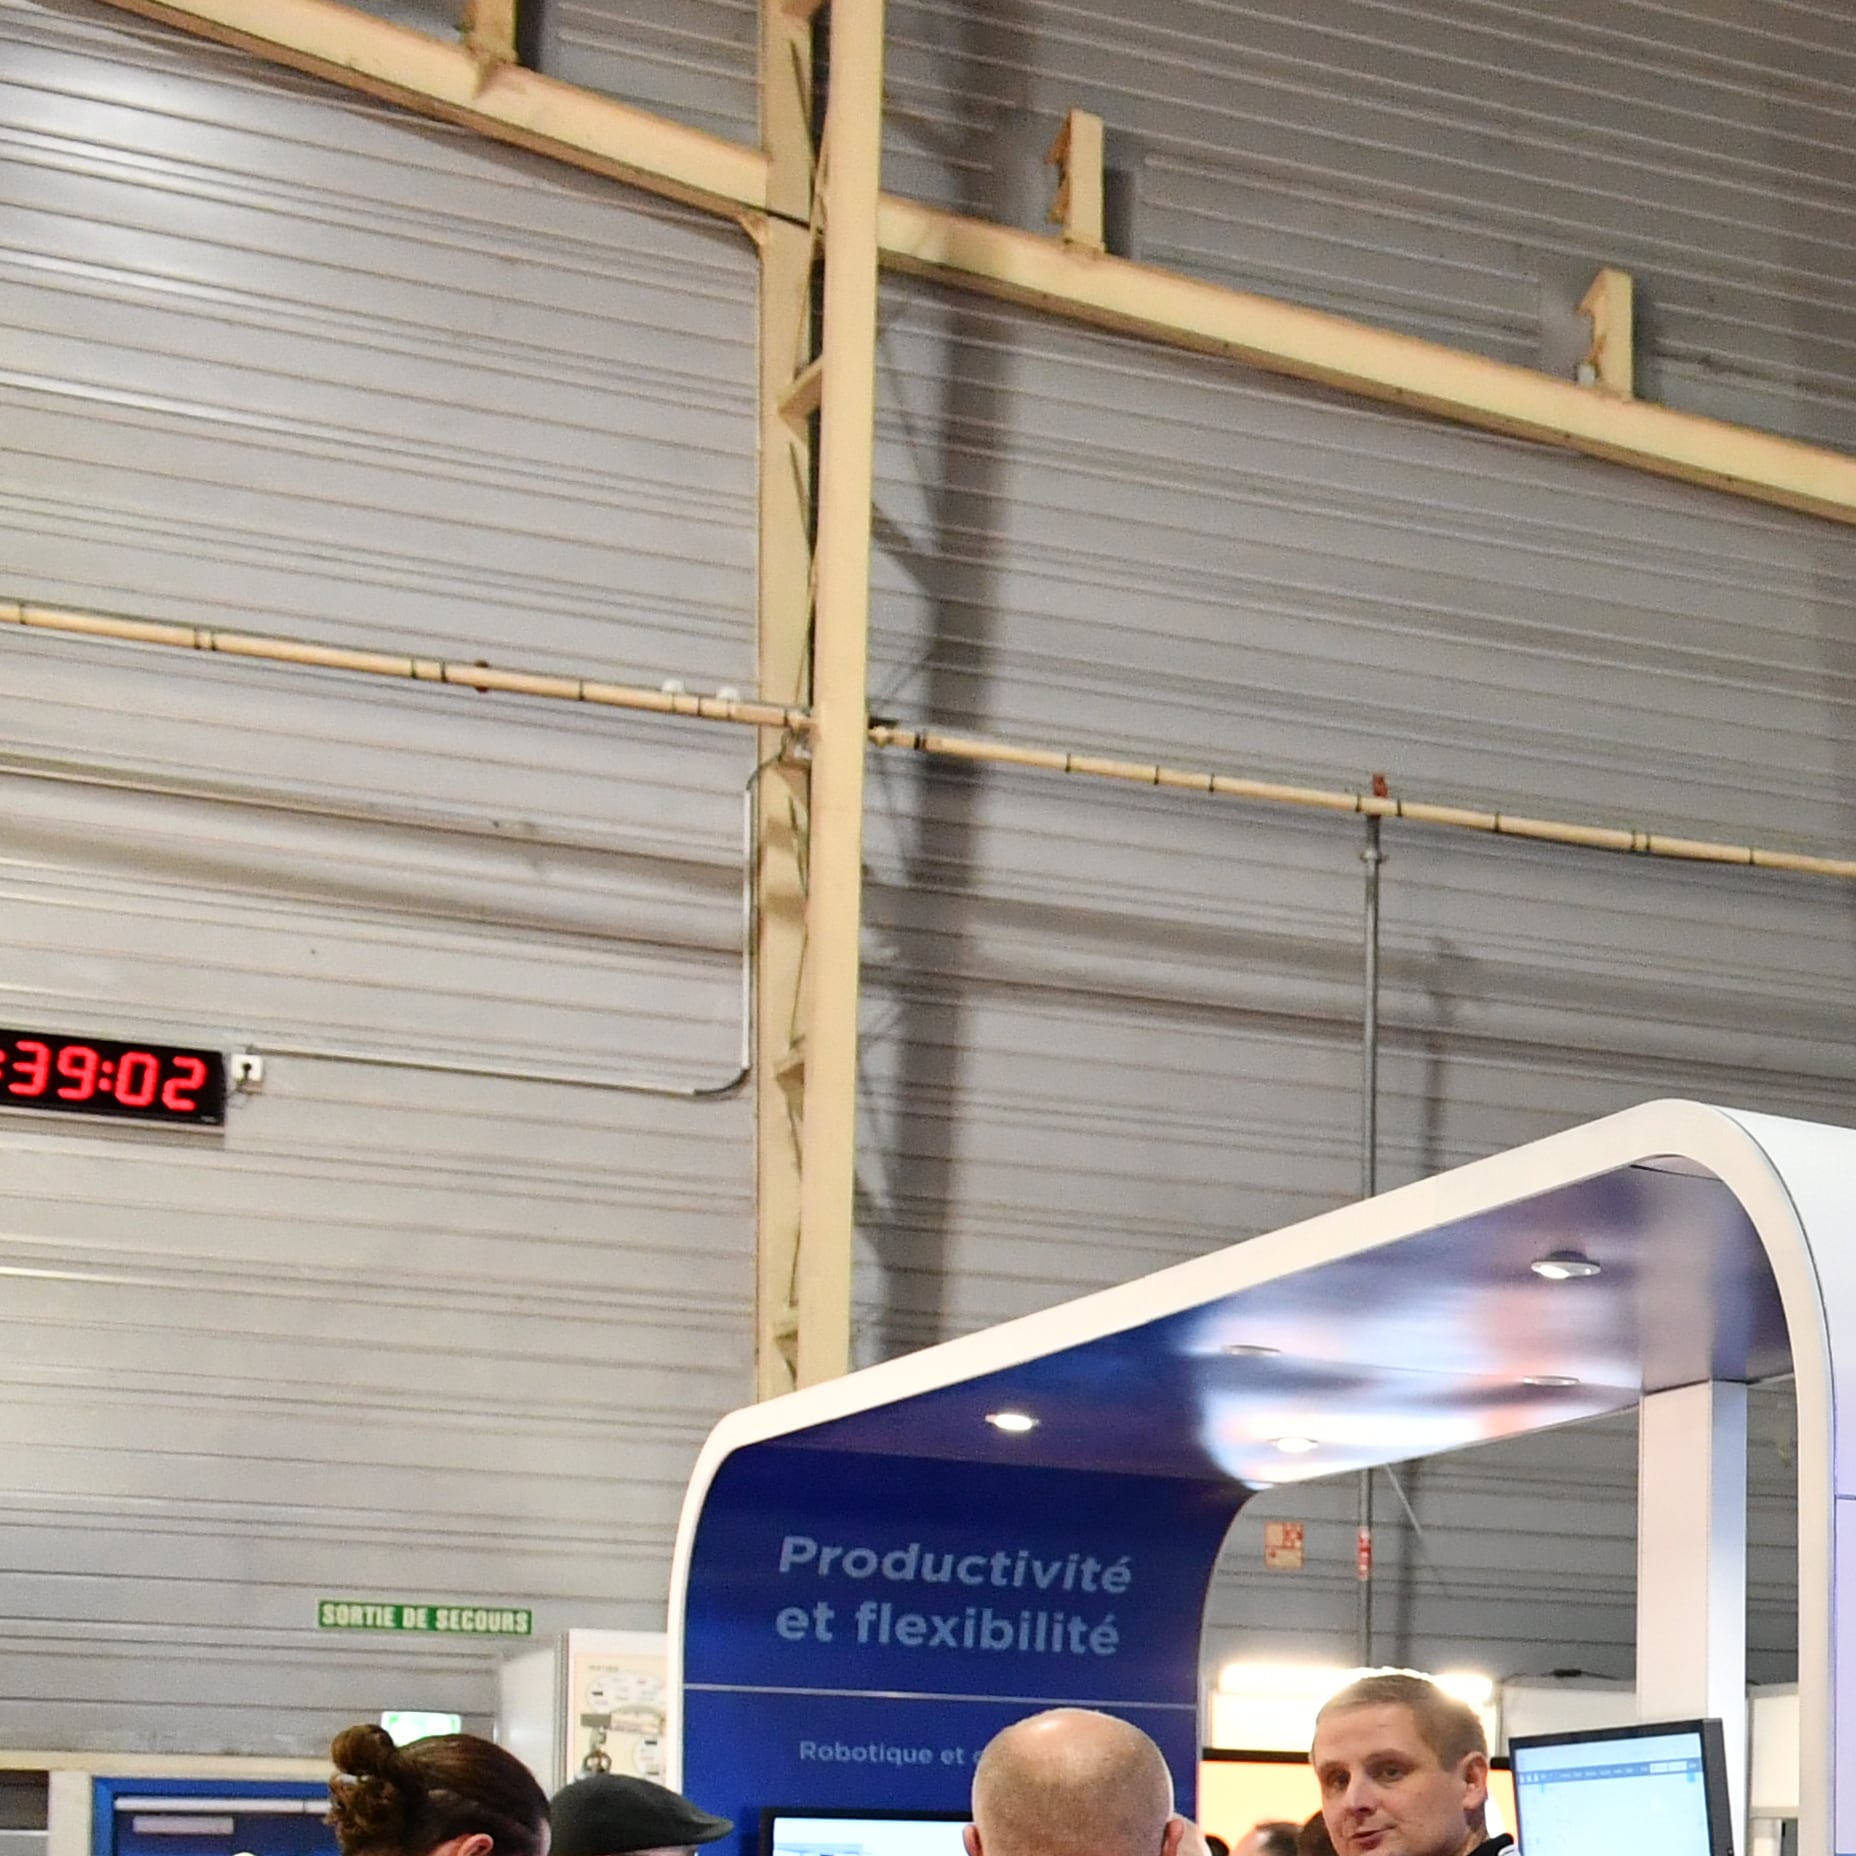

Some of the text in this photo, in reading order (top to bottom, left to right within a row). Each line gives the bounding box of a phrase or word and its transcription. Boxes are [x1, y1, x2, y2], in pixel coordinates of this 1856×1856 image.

[778, 1535, 1132, 1595] Productivité
[321, 1603, 529, 1635] SORTIE DE SECOURS
[775, 1600, 1120, 1656] et flexibilité
[798, 1739, 932, 1767] Robotique
[940, 1745, 966, 1766] et
